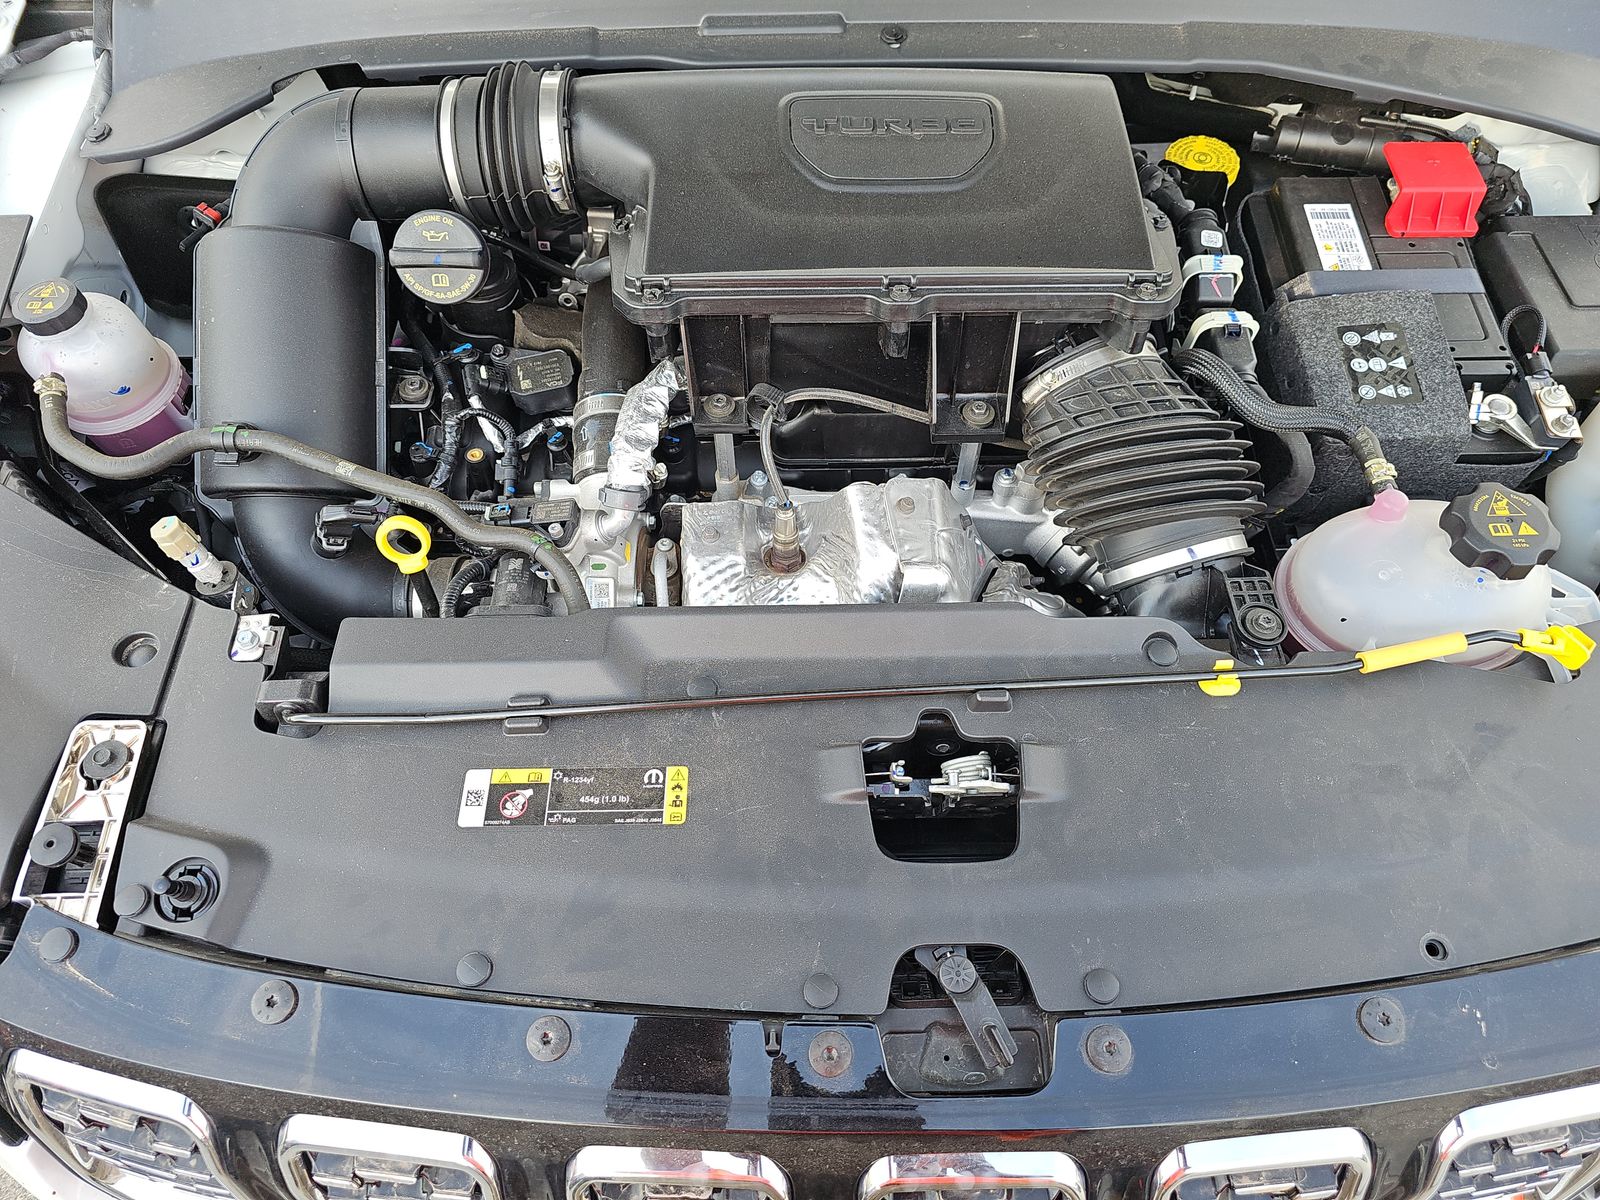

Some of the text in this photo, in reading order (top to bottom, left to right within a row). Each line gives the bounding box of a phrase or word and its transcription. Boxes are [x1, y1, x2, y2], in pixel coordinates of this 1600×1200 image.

[801, 115, 984, 136] TURBO
[413, 215, 455, 228] ENGINE OIL
[404, 273, 415, 285] API
[563, 776, 595, 785] R-1234yf
[579, 795, 630, 805] 454g (1.0 lb)
